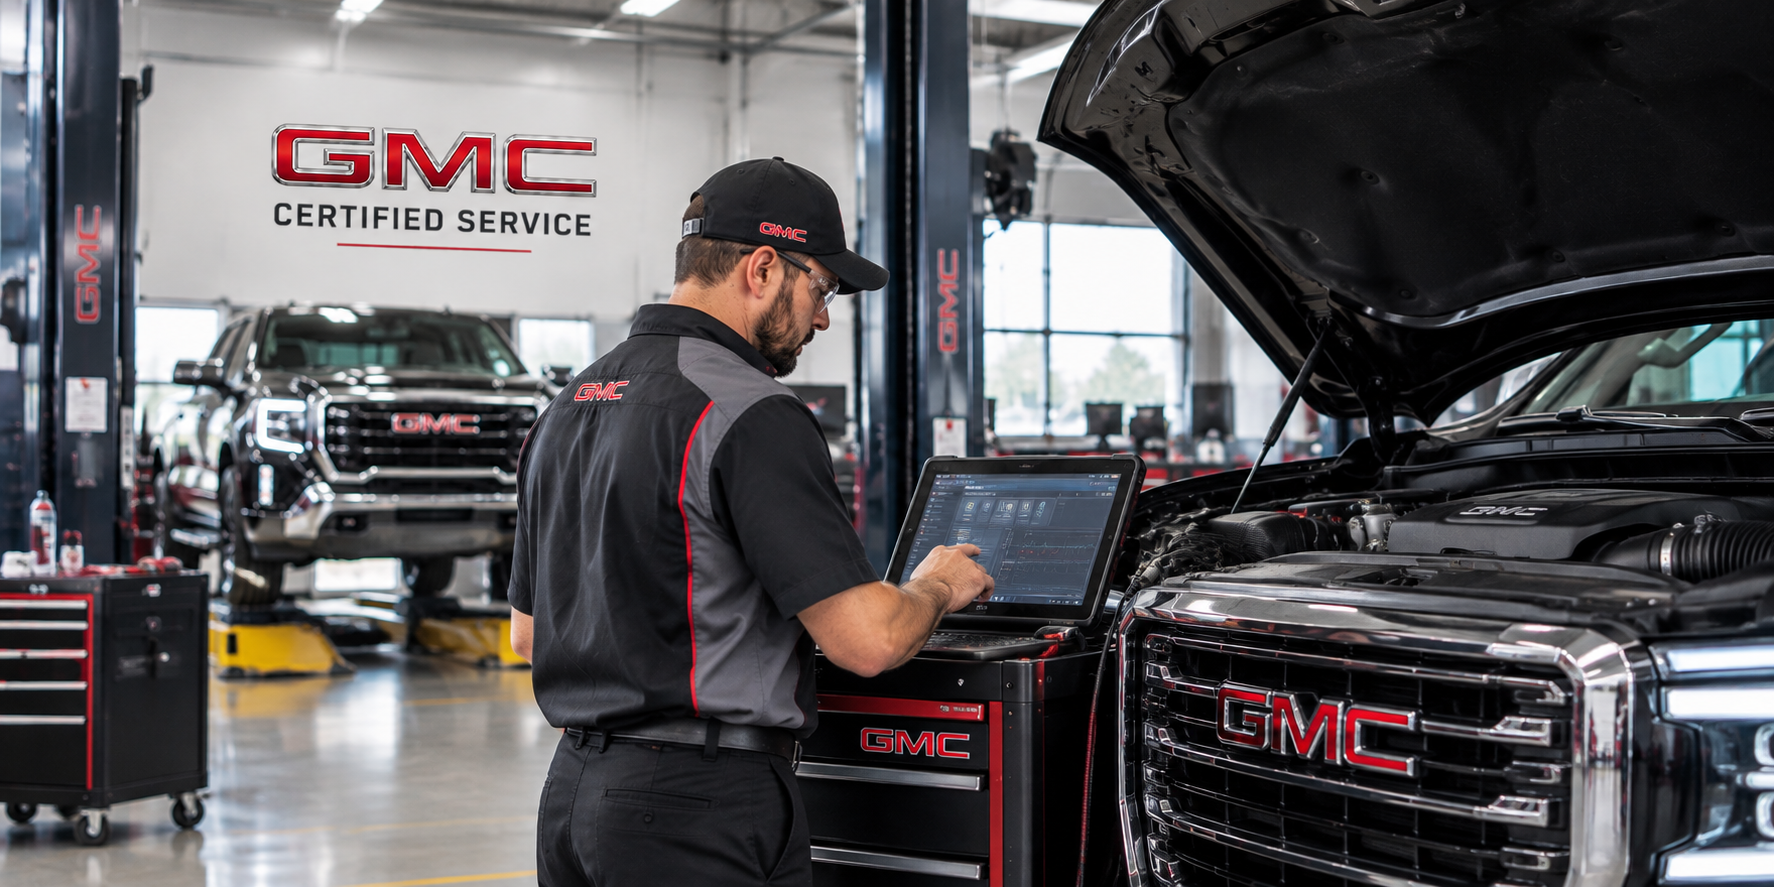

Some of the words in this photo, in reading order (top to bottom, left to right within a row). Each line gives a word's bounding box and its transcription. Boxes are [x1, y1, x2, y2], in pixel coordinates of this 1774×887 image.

[271, 123, 597, 197] GMC
[273, 202, 444, 231] CERTIFIED
[457, 209, 592, 236] SERVICE
[759, 221, 807, 243] GMC
[74, 204, 102, 324] GMC
[937, 248, 960, 354] GMC
[574, 381, 630, 402] GMC
[391, 412, 480, 436] GMC
[861, 727, 970, 759] GMC
[1216, 680, 1415, 777] GMC
